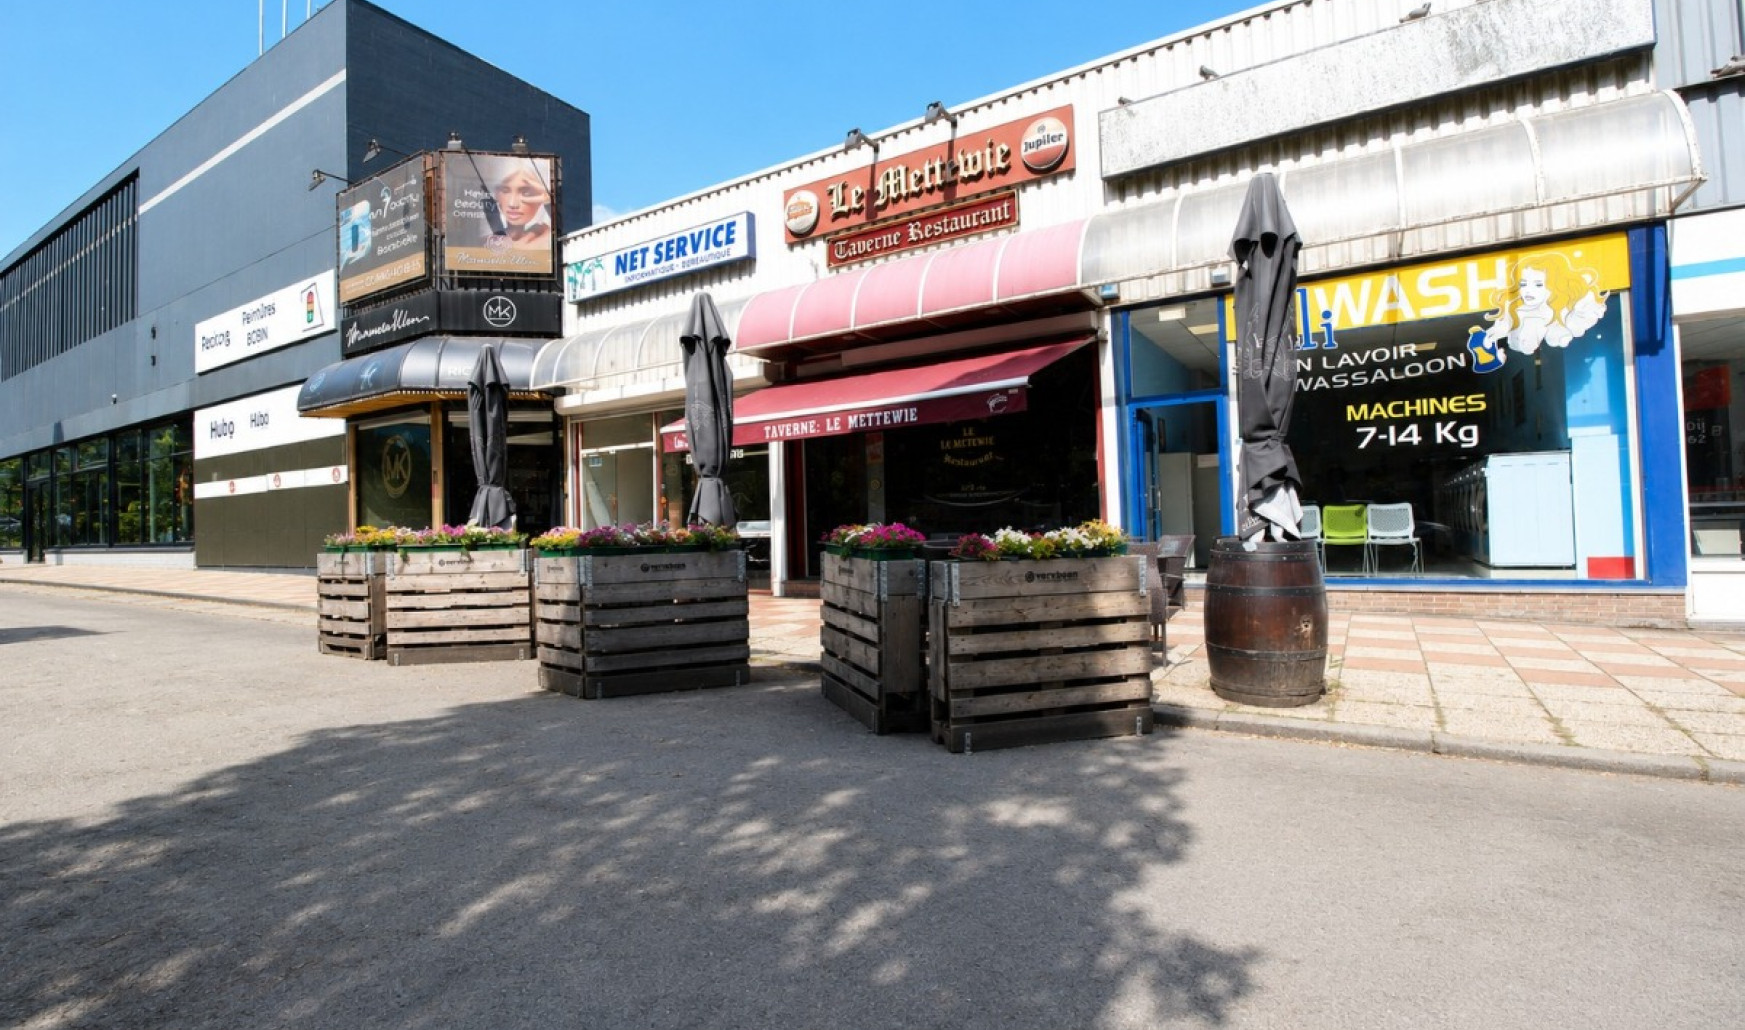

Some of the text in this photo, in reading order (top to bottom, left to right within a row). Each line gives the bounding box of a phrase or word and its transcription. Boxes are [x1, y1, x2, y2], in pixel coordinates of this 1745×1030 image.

[1023, 133, 1064, 153] Jupiler
[828, 181, 864, 220] Le
[834, 201, 1011, 260] Taverne Restaurant
[615, 220, 736, 276] NET SERVICE
[1314, 257, 1510, 328] WASH
[1322, 342, 1418, 370] LAVOIR
[764, 406, 918, 439] TAVERNE: LE METTEWIE
[1346, 393, 1488, 421] MACHINES
[1356, 420, 1481, 449] 7-14 Kg
